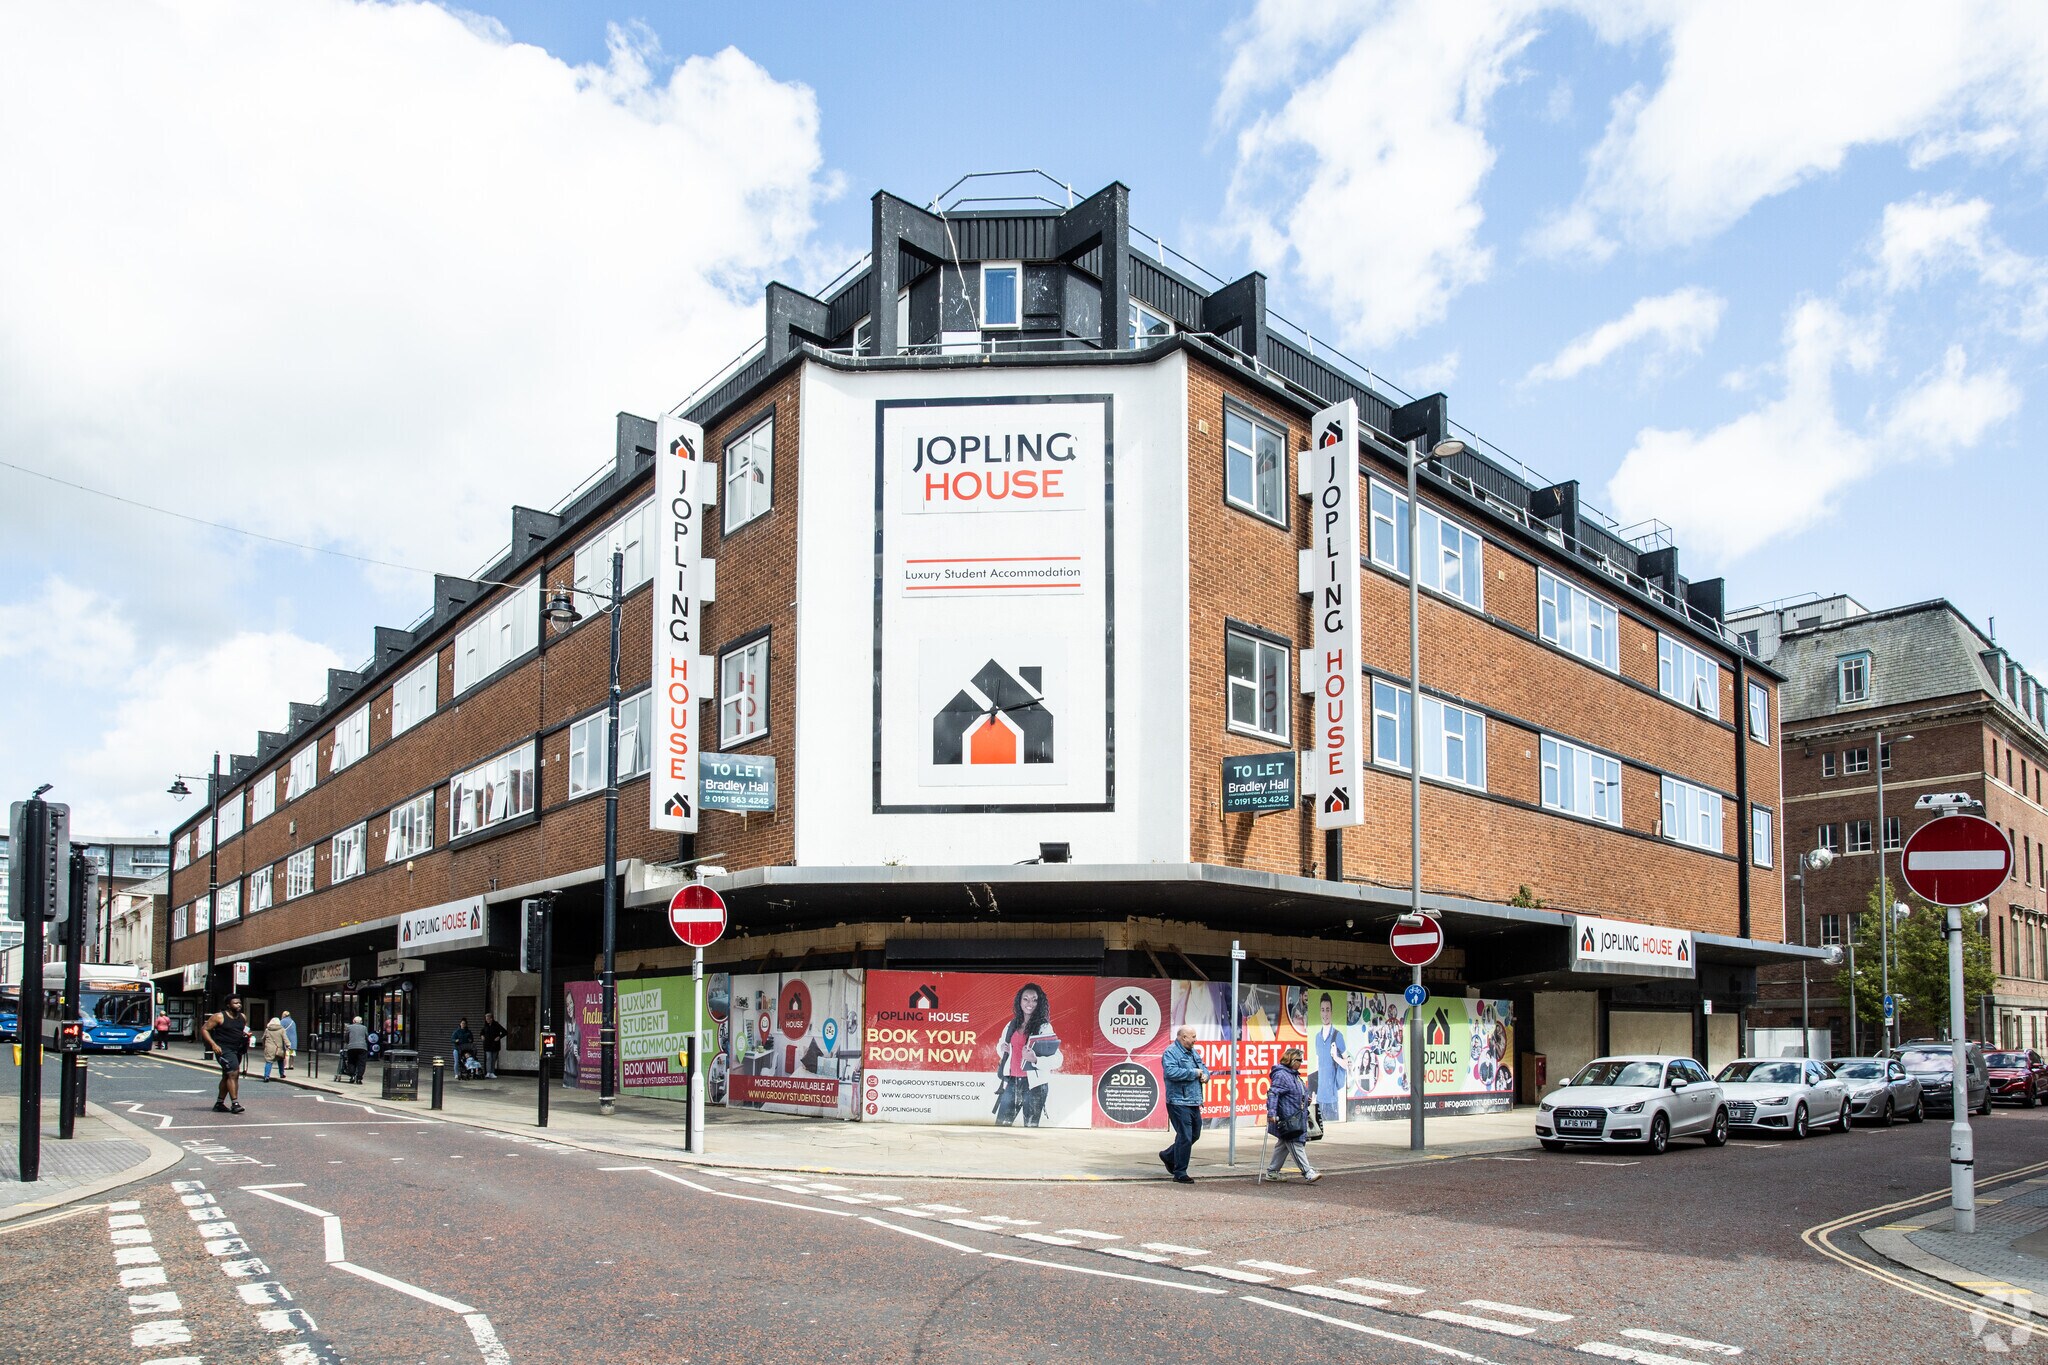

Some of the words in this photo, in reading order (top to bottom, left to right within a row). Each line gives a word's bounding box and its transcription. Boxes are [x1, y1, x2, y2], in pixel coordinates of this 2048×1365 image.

[912, 433, 1077, 473] JOPLING
[925, 469, 1064, 501] HOUSE
[1323, 456, 1344, 633] JOPLING
[669, 469, 692, 643] JOPLING
[905, 570, 941, 581] Luxury
[945, 568, 986, 579] Student
[990, 566, 1081, 578] Accommodation
[669, 657, 690, 781] HOUSE
[1326, 648, 1345, 775] HOUSE
[710, 763, 731, 776] TO
[735, 764, 764, 777] LET
[1233, 765, 1252, 778] TO
[1257, 762, 1285, 776] LET
[705, 779, 746, 794] Bradley
[748, 781, 769, 792] Hall
[1228, 781, 1267, 794] Bradley
[1269, 778, 1289, 790] Hall
[712, 795, 729, 803] 0191
[1234, 798, 1250, 806] 0191
[1268, 795, 1289, 803] 4242
[414, 917, 440, 939] JOPLING
[442, 911, 467, 931] HOUSE
[1600, 932, 1639, 952] JOPLING
[1643, 937, 1673, 955] HOUSE
[326, 963, 342, 977] HOUSE
[586, 993, 598, 1004] ALL
[621, 992, 659, 1012] LUXURY
[622, 1014, 665, 1034] STUDENT
[877, 1011, 923, 1022] JOPLING
[928, 1012, 969, 1022] HOUSE
[1110, 1017, 1148, 1026] JOPLING
[867, 1028, 918, 1043] BOOK
[925, 1030, 977, 1045] YOUR
[1112, 1027, 1146, 1035] HOUSE
[869, 1047, 924, 1062] ROOM
[927, 1048, 973, 1063] NOW
[624, 1062, 645, 1076] BOOK
[645, 1060, 667, 1074] NOW!
[754, 1079, 770, 1087] MORE
[770, 1080, 792, 1089] ROOMS
[792, 1080, 825, 1091] AVAILABLE
[826, 1082, 834, 1091] AT
[881, 1079, 986, 1087] INFO@GROOVYSTUDENTS.CO.UK
[1111, 1074, 1146, 1086] 2018
